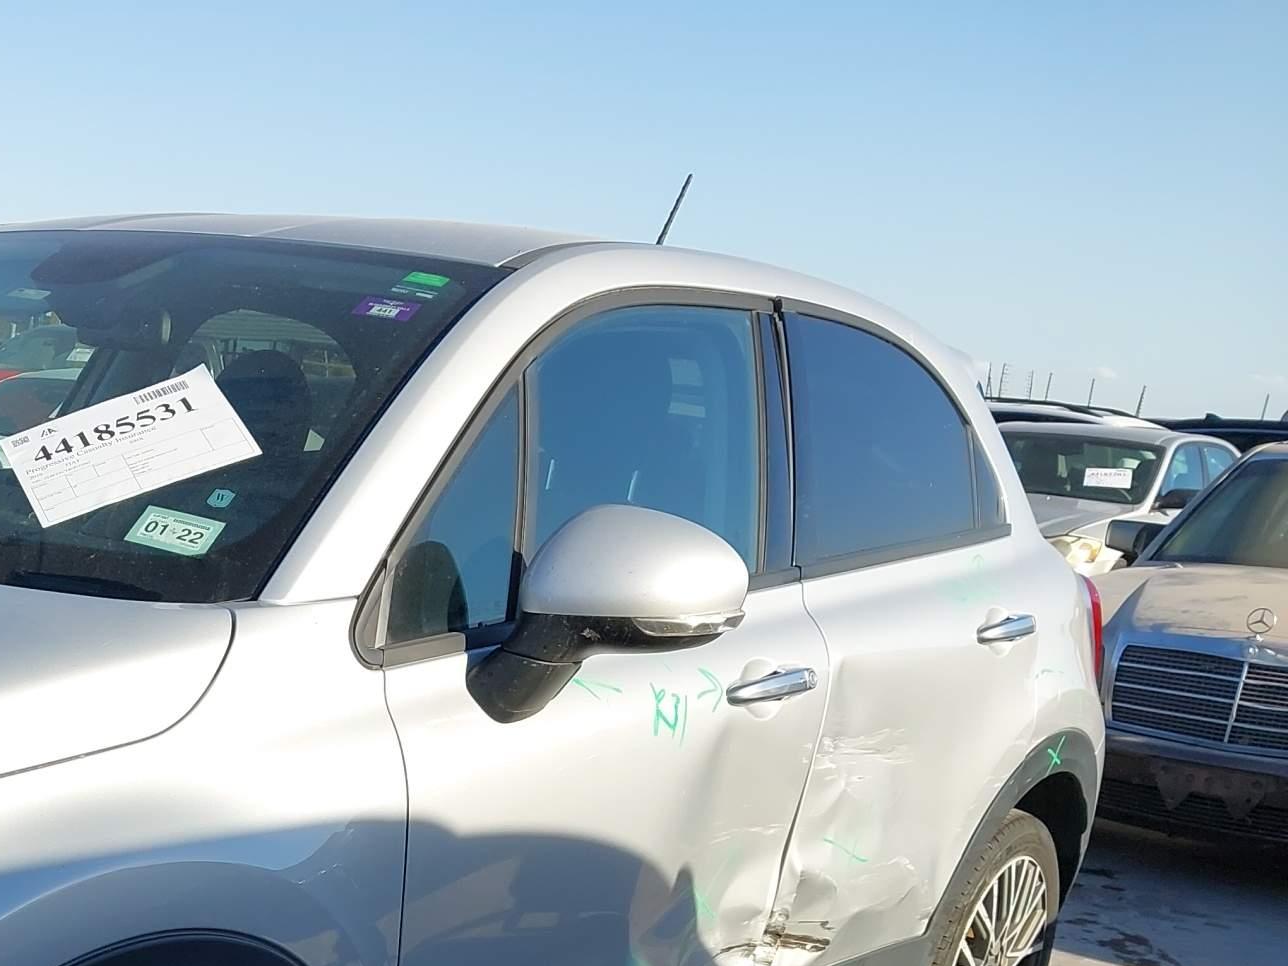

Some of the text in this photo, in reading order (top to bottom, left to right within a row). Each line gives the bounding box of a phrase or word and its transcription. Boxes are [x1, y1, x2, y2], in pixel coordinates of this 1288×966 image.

[33, 396, 199, 462] 44185531
[144, 520, 170, 537] 01
[175, 528, 205, 546] 22
